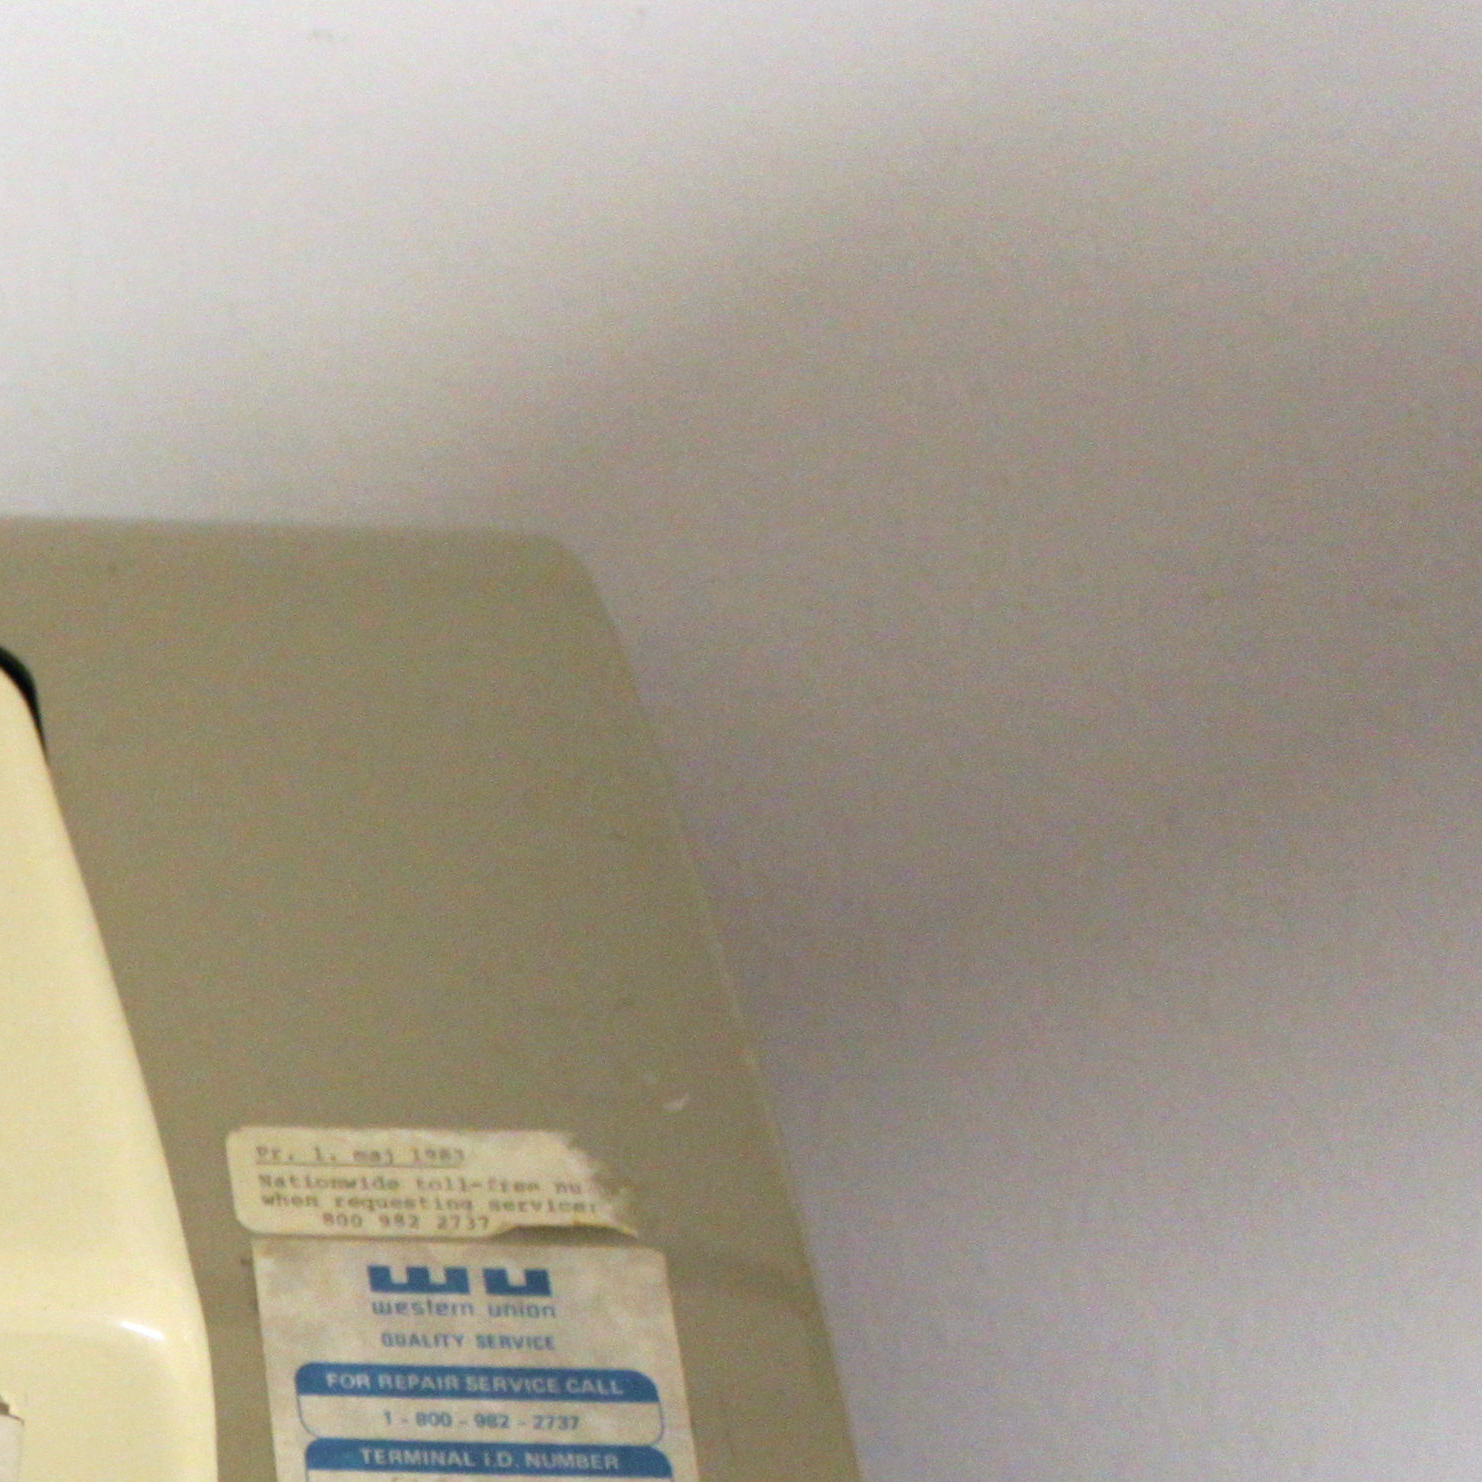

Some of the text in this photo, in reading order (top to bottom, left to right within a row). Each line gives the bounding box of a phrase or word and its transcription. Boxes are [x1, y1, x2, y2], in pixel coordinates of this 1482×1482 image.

[259, 1175, 541, 1193] Nationwide toll-free
[262, 1194, 318, 1208] when
[335, 1196, 472, 1213] requesting
[372, 1300, 556, 1318] western union
[382, 1333, 555, 1350] QUALITY SERVICE
[327, 1374, 623, 1394] FOR REPAIR SERVICE CALL
[360, 1448, 475, 1467] TERMINAL
[525, 1455, 619, 1469] NUMBER
